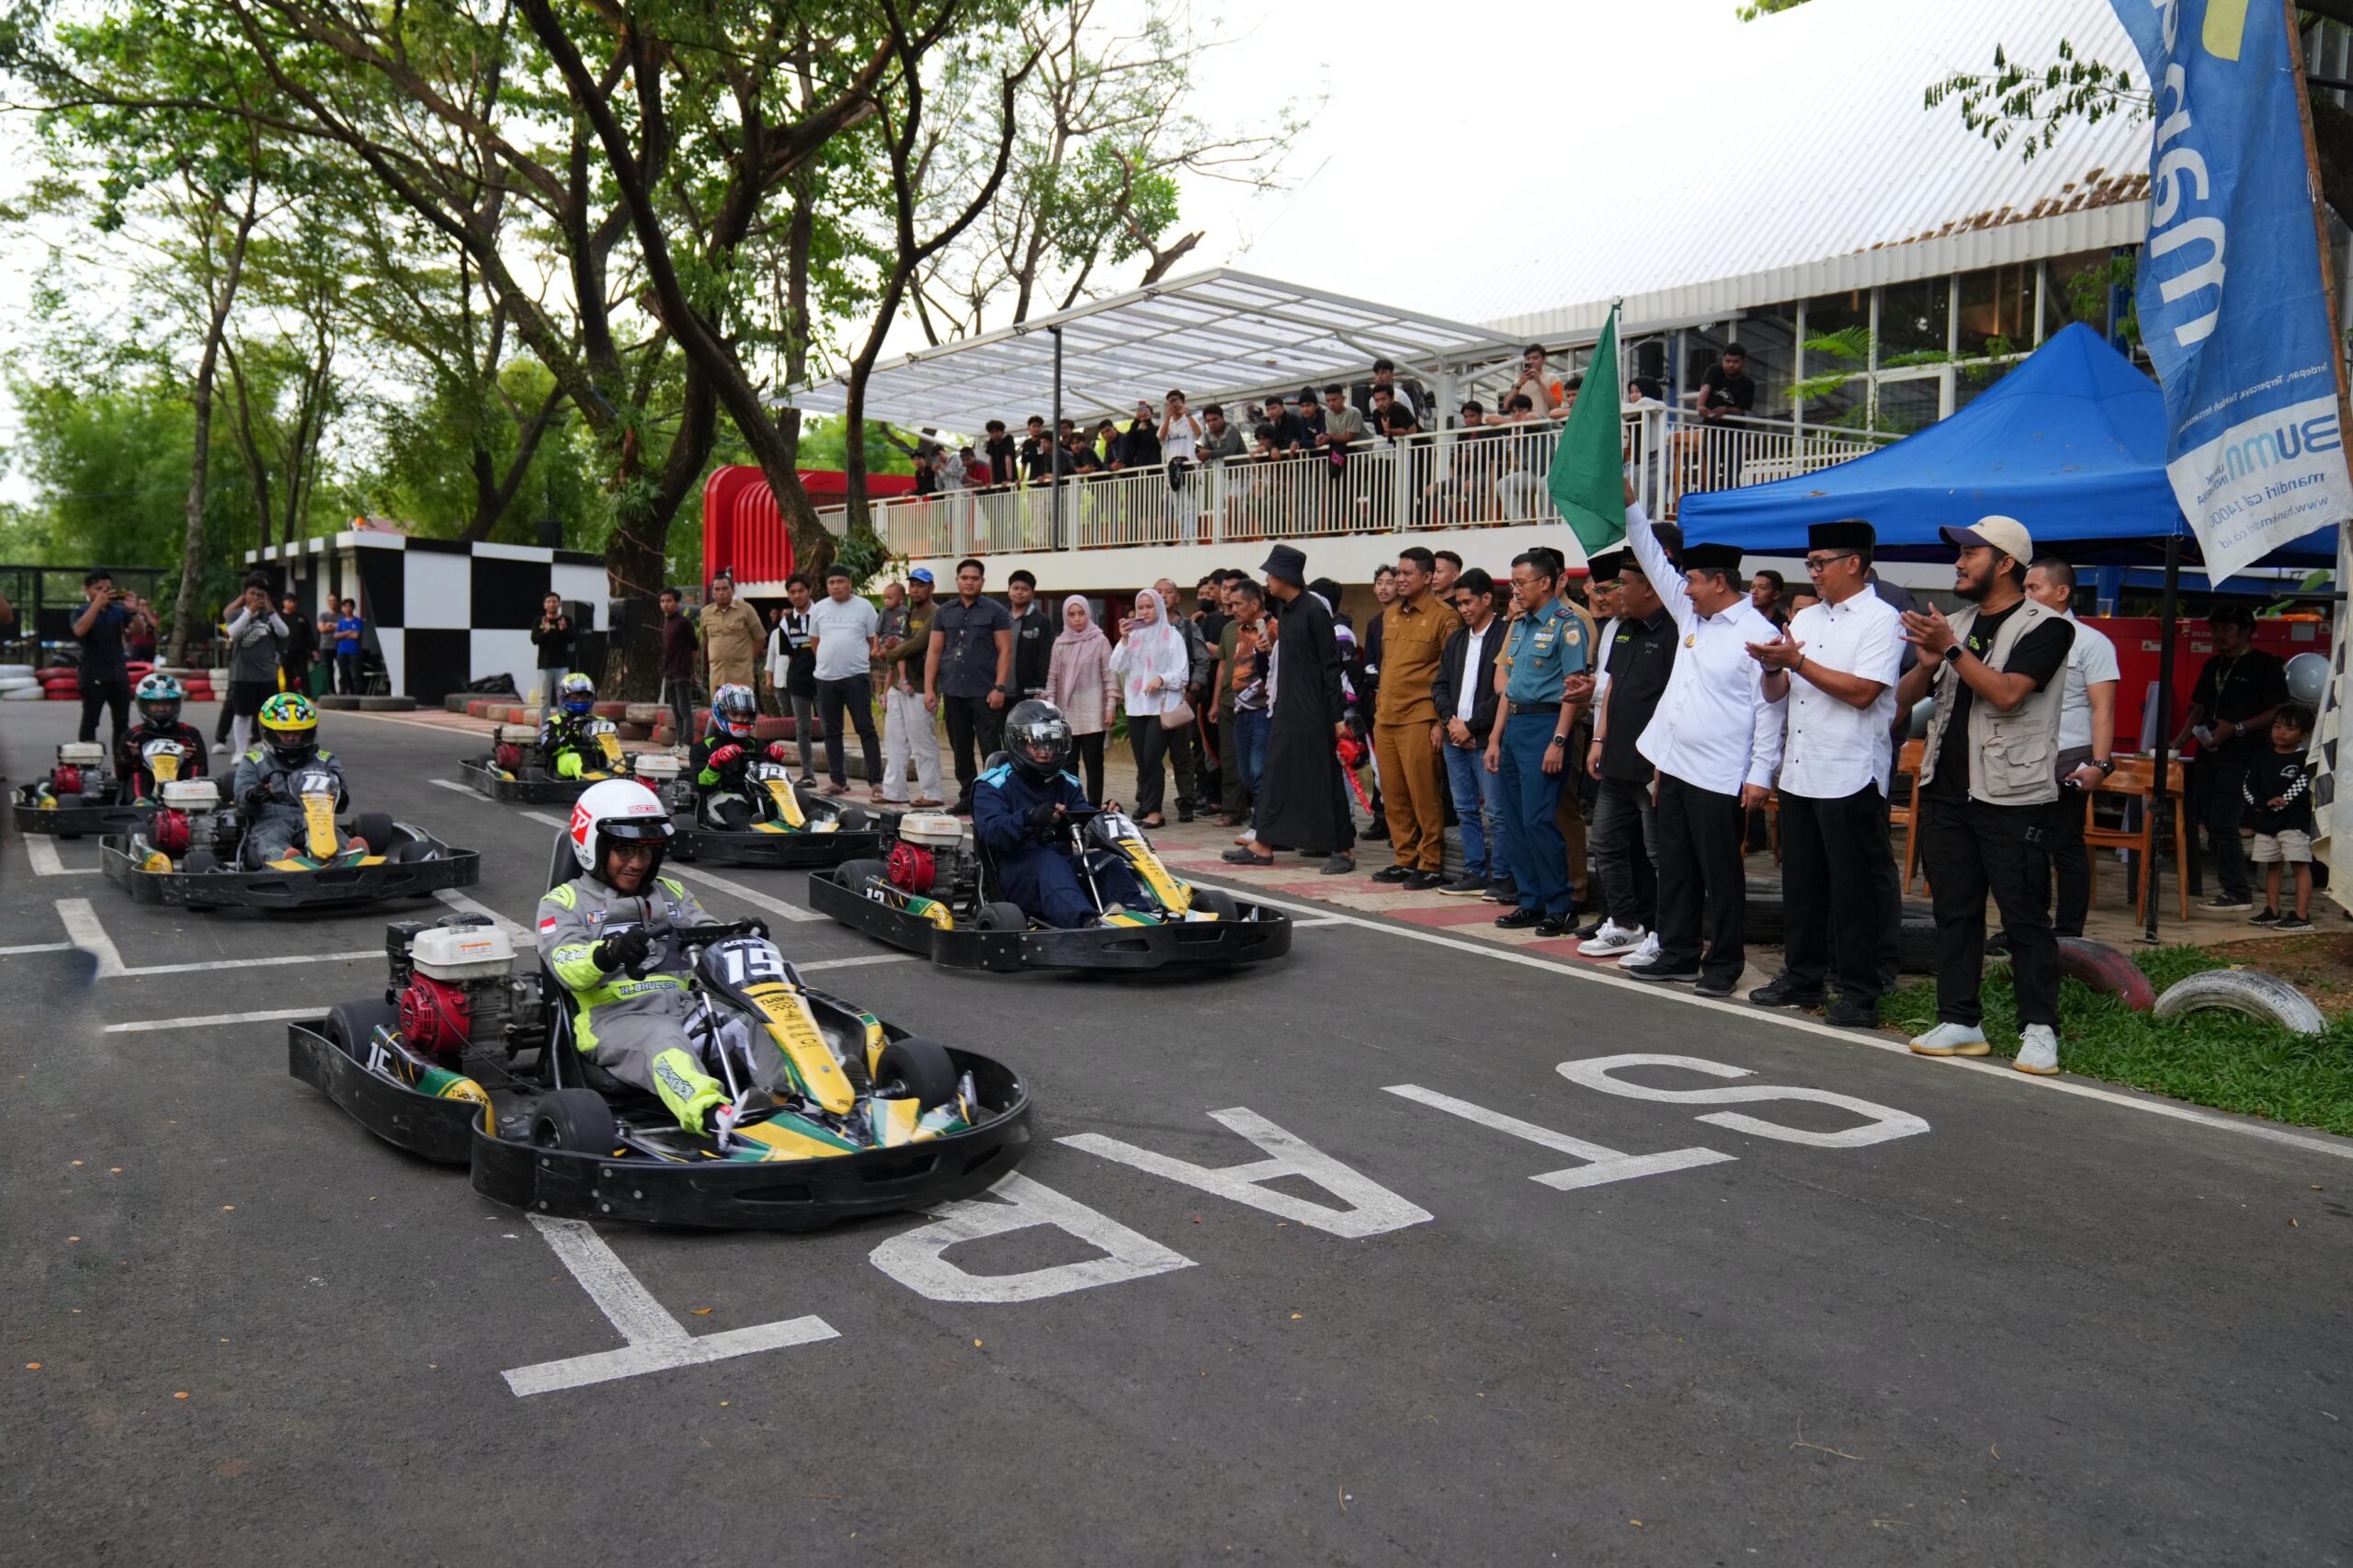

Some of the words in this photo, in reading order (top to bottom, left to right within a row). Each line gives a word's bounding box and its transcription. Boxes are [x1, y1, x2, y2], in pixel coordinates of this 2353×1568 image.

[591, 721, 617, 735] 10
[759, 767, 787, 780] 14
[301, 775, 331, 791] 11
[722, 948, 784, 984] 15
[502, 1052, 1930, 1396] START
